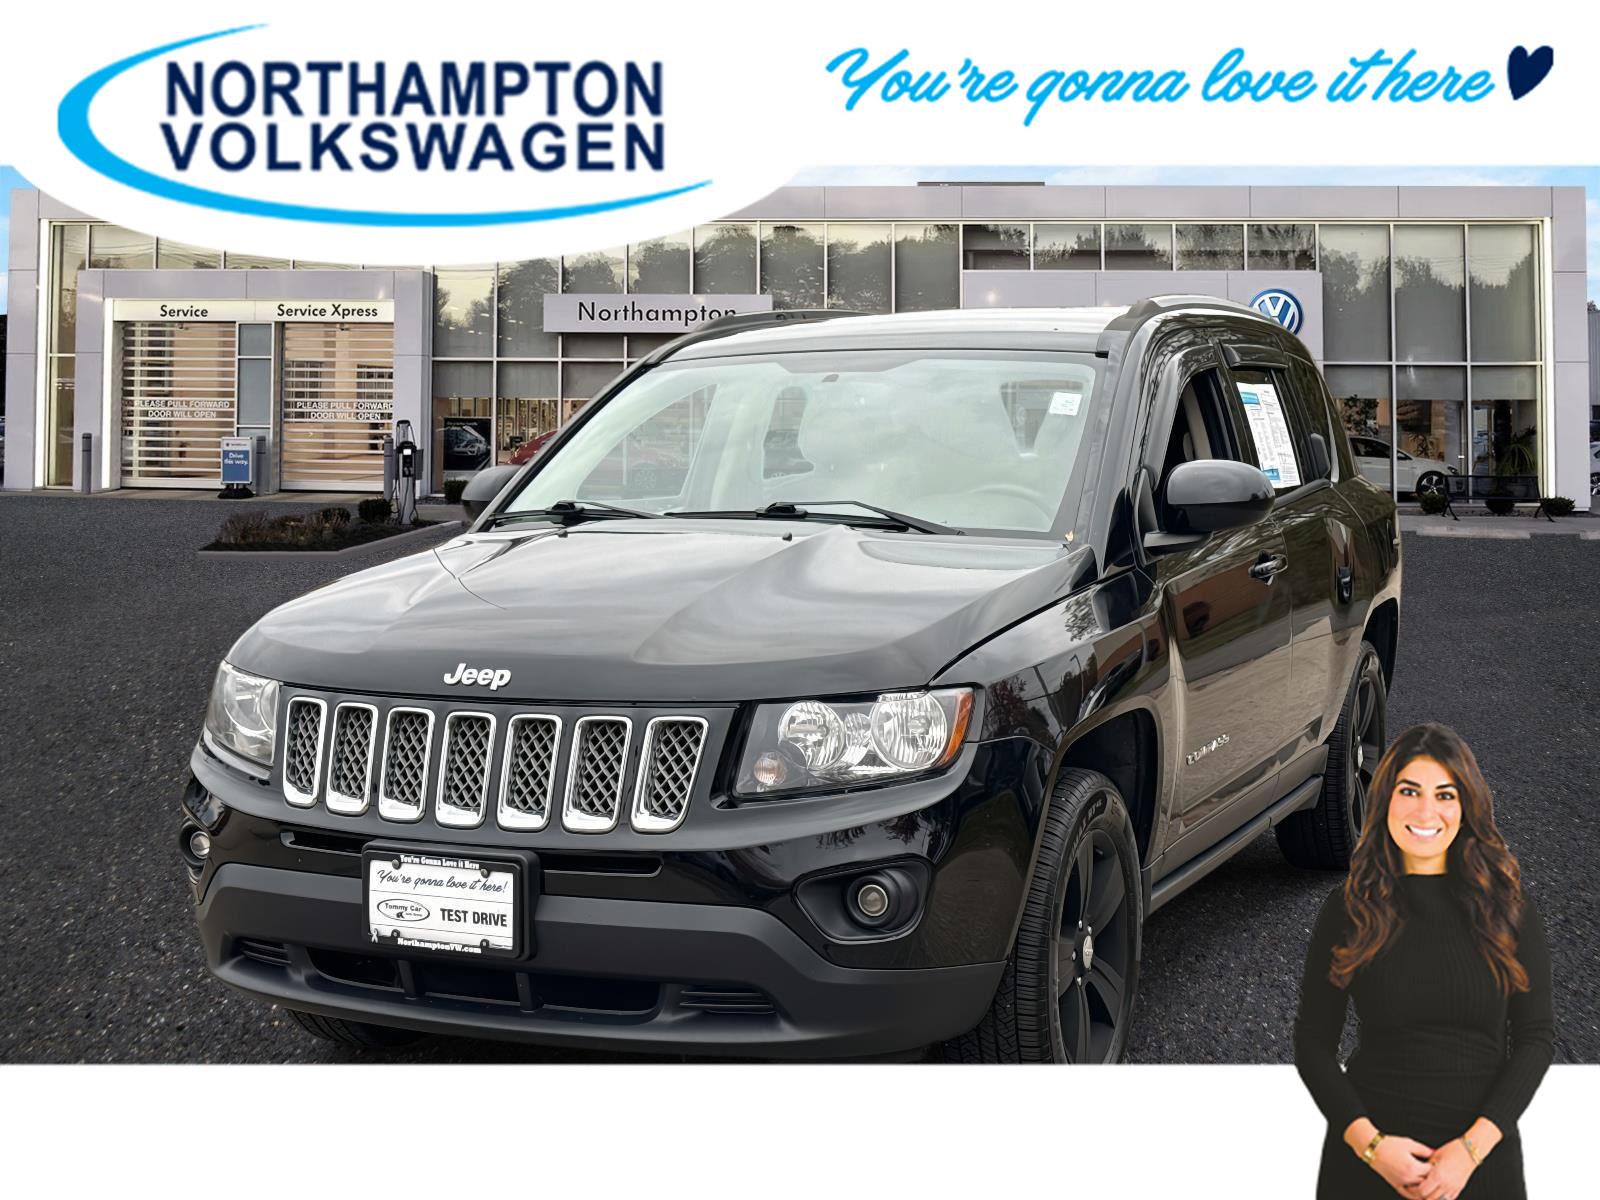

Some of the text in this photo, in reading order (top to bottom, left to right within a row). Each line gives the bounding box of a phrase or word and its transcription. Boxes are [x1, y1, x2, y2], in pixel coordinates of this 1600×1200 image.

[160, 304, 208, 317] Service
[277, 303, 378, 319] Service Xpress
[135, 400, 230, 409] PLEASE PULL FORWARD
[297, 402, 329, 410] PLEASE
[330, 402, 352, 410] PULL
[148, 410, 217, 418] DOOR WILL OPEN
[311, 412, 381, 420] DOOR WILL OPEN
[443, 662, 512, 691] Jeep
[377, 869, 508, 893] You're gonna love it here!
[385, 902, 408, 911] Tommy
[440, 907, 508, 928] TEST DRIVE
[397, 937, 482, 954] NorthamptonVW.com
